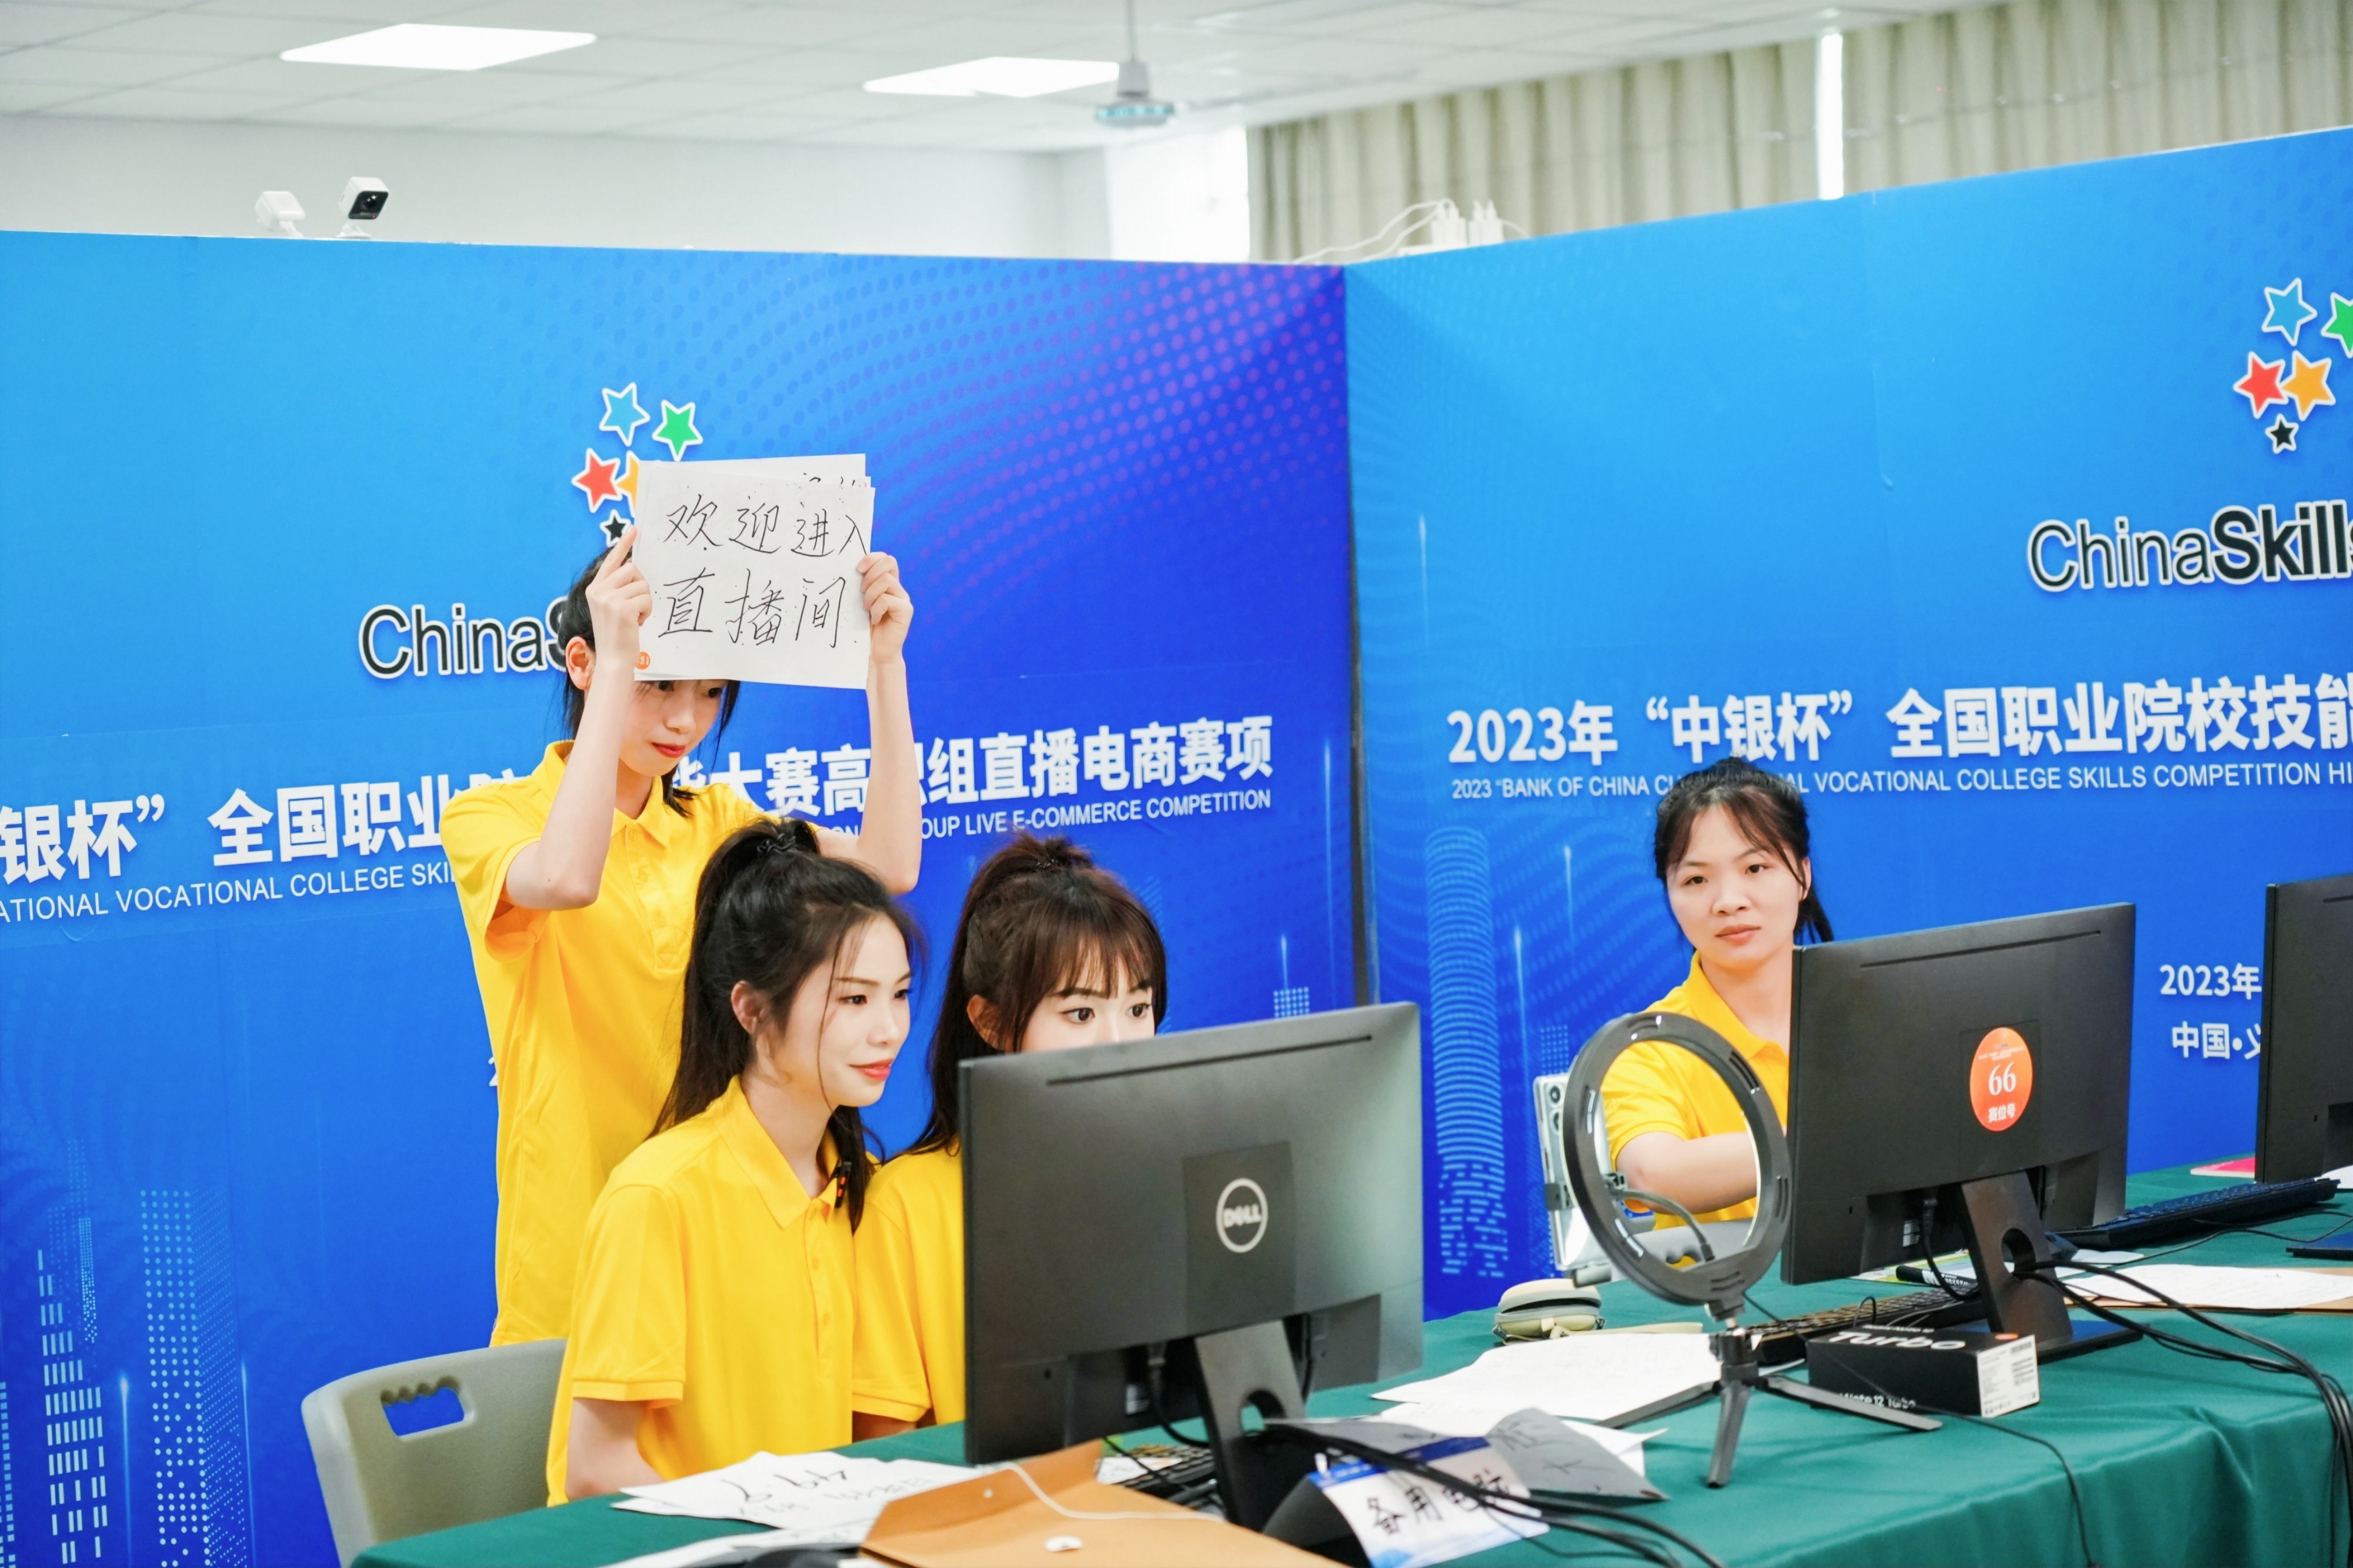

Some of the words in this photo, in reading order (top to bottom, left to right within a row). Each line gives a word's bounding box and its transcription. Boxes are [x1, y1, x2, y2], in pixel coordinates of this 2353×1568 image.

[663, 494, 869, 558] 欢迎进入
[2027, 499, 2353, 592] ChinaSkill
[658, 567, 846, 648] 直播间
[1452, 779, 1492, 799] 2023
[1558, 777, 1583, 796] OF
[1589, 775, 1649, 796] CHINA
[1814, 770, 1951, 793] VOCATIONAL
[1957, 768, 2062, 790] COLLEGE
[2069, 766, 2147, 789] SKILLS
[2154, 762, 2320, 787] COMPETITION
[207, 768, 529, 866] 全国职业
[116, 877, 284, 912] VOCATIONAL
[290, 865, 404, 897] COLLEGE
[412, 861, 455, 886] SKI
[965, 812, 1008, 836] LIVE
[1012, 800, 1142, 832] E-COMMERCE
[1146, 788, 1272, 818] COMPETITION
[2159, 962, 2262, 1000] 2023年
[1988, 1062, 2017, 1096] 66
[1988, 1103, 2016, 1123] 赛位号
[1224, 1203, 1262, 1228] DELL
[1828, 1331, 1966, 1350] Turbo
